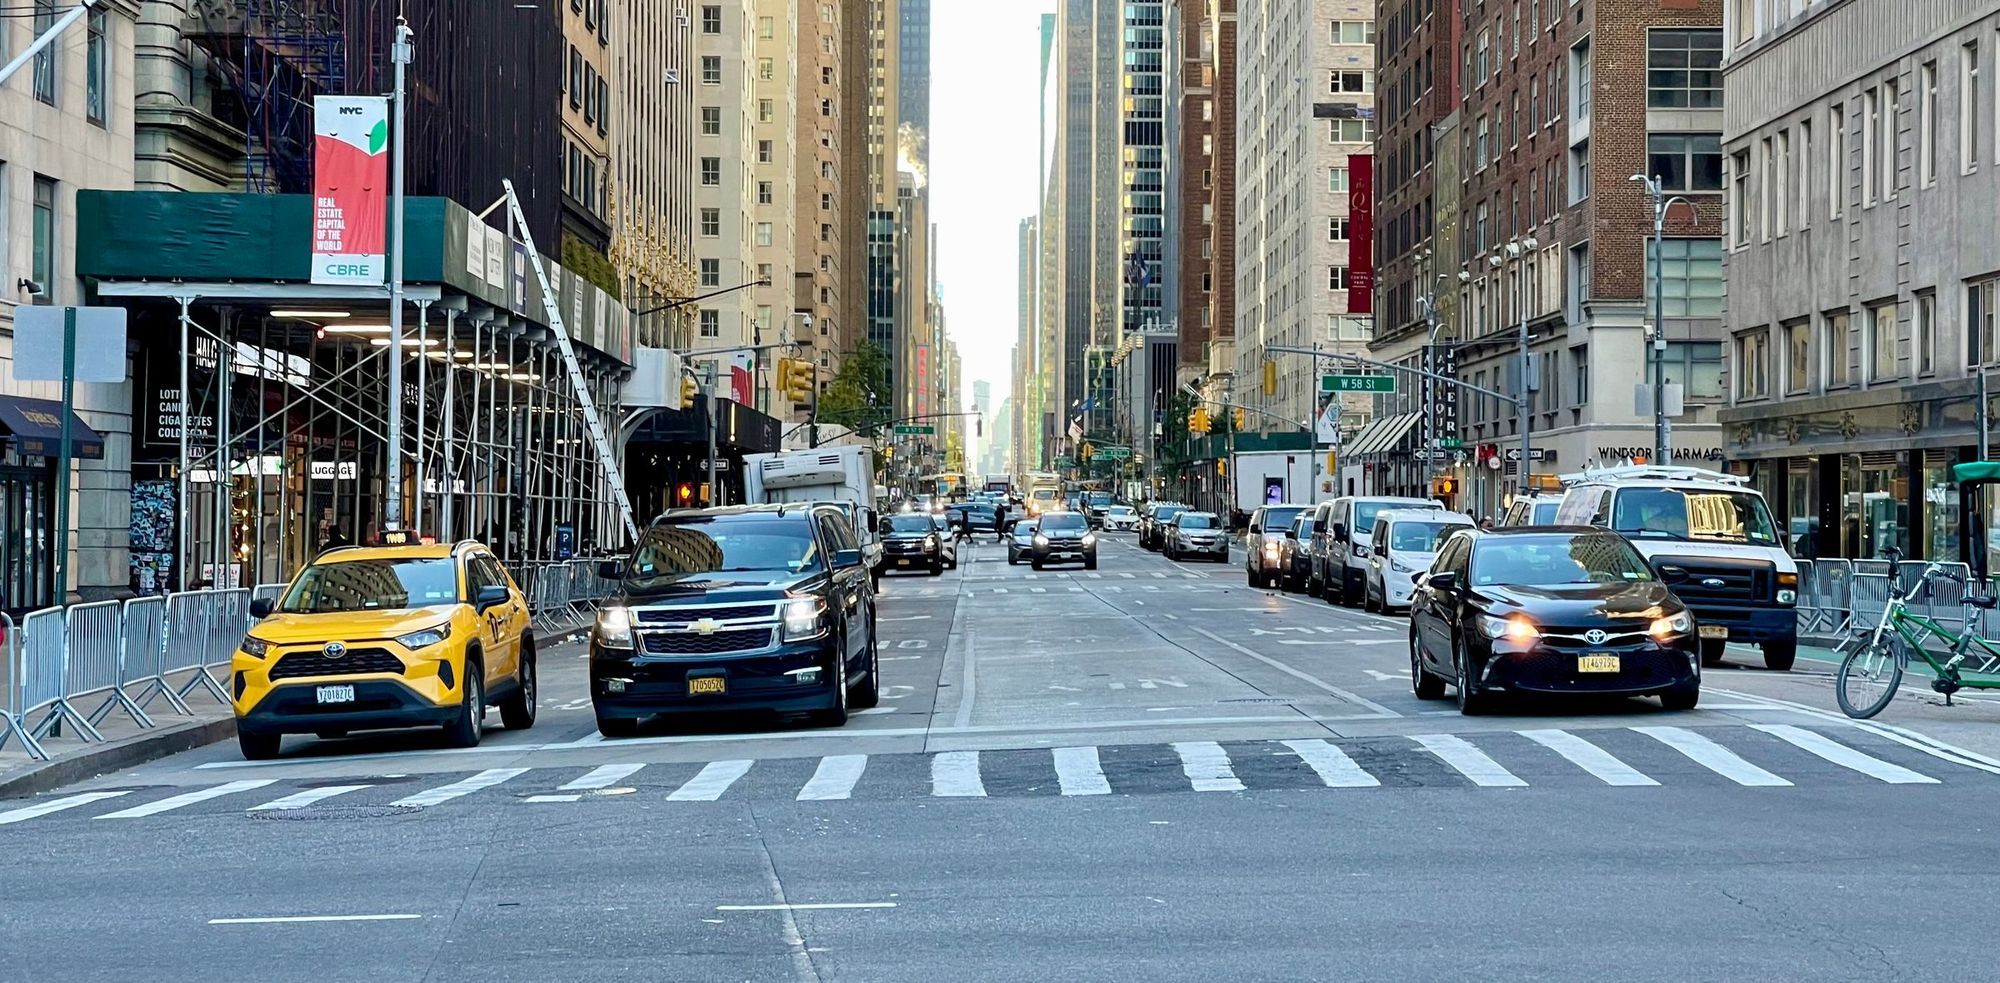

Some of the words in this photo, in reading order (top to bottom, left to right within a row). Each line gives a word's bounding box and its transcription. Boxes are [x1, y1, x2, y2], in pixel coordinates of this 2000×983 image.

[339, 107, 363, 115] NYC
[318, 197, 335, 207] REAL
[318, 208, 343, 218] ESTATE
[317, 219, 345, 229] CAPITAL
[317, 230, 326, 240] OF
[328, 230, 341, 240] THE
[317, 240, 342, 251] WORLD
[326, 265, 369, 276] CBRE
[1341, 379, 1348, 389] W
[1351, 379, 1362, 389] 58
[1366, 379, 1375, 389] St
[160, 389, 182, 400] LOTT
[159, 415, 212, 427] CIGAETTES
[158, 428, 181, 438] COLD
[1598, 447, 1652, 460] WINDSOR
[1671, 448, 1723, 461] ARMAC
[311, 466, 352, 475] UGGGE
[563, 534, 569, 542] P
